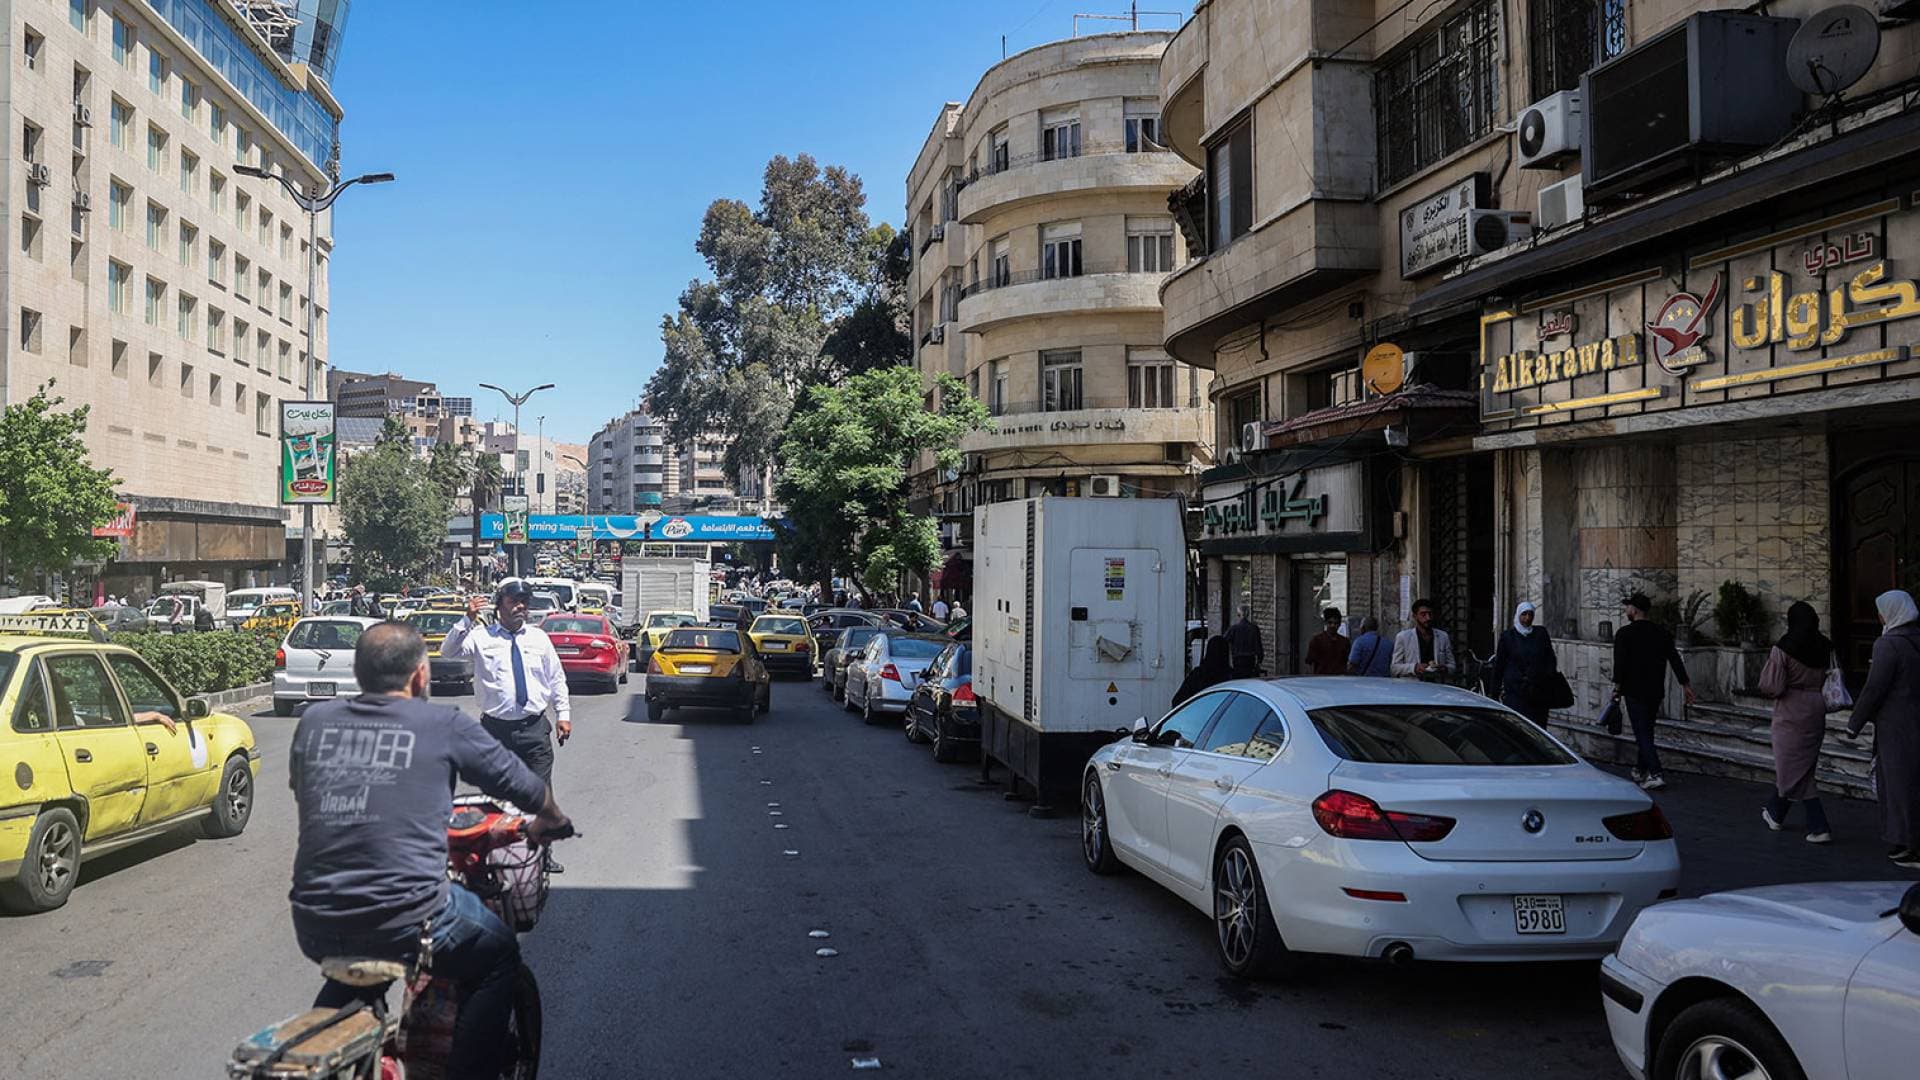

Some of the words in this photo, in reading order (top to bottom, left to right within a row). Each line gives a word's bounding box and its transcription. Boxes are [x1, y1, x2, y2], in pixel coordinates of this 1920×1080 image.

[1803, 231, 1874, 277] نادي
[1731, 259, 1920, 351] كروان
[1492, 333, 1639, 394] Alkarawan
[311, 408, 332, 420] بكل
[1094, 418, 1126, 431] فندق
[38, 617, 88, 631] TAXI
[320, 785, 370, 814] URBAN
[1518, 909, 1562, 930] 5980
